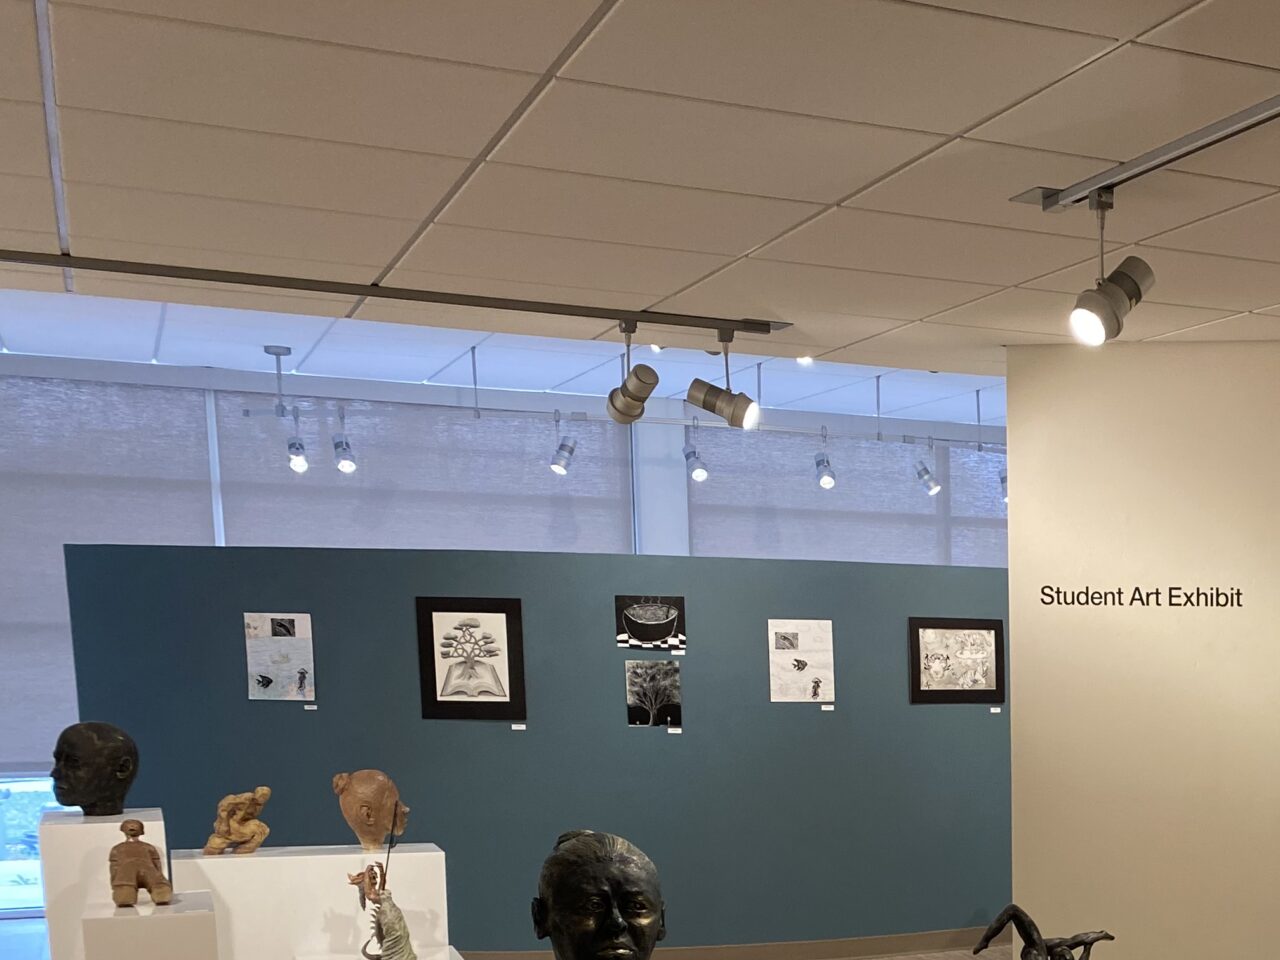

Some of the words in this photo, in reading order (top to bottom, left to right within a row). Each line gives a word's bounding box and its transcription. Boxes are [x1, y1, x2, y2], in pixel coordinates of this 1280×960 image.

[1040, 585, 1124, 606] Student
[1129, 586, 1162, 607] Art
[1168, 586, 1243, 608] Exhibit
